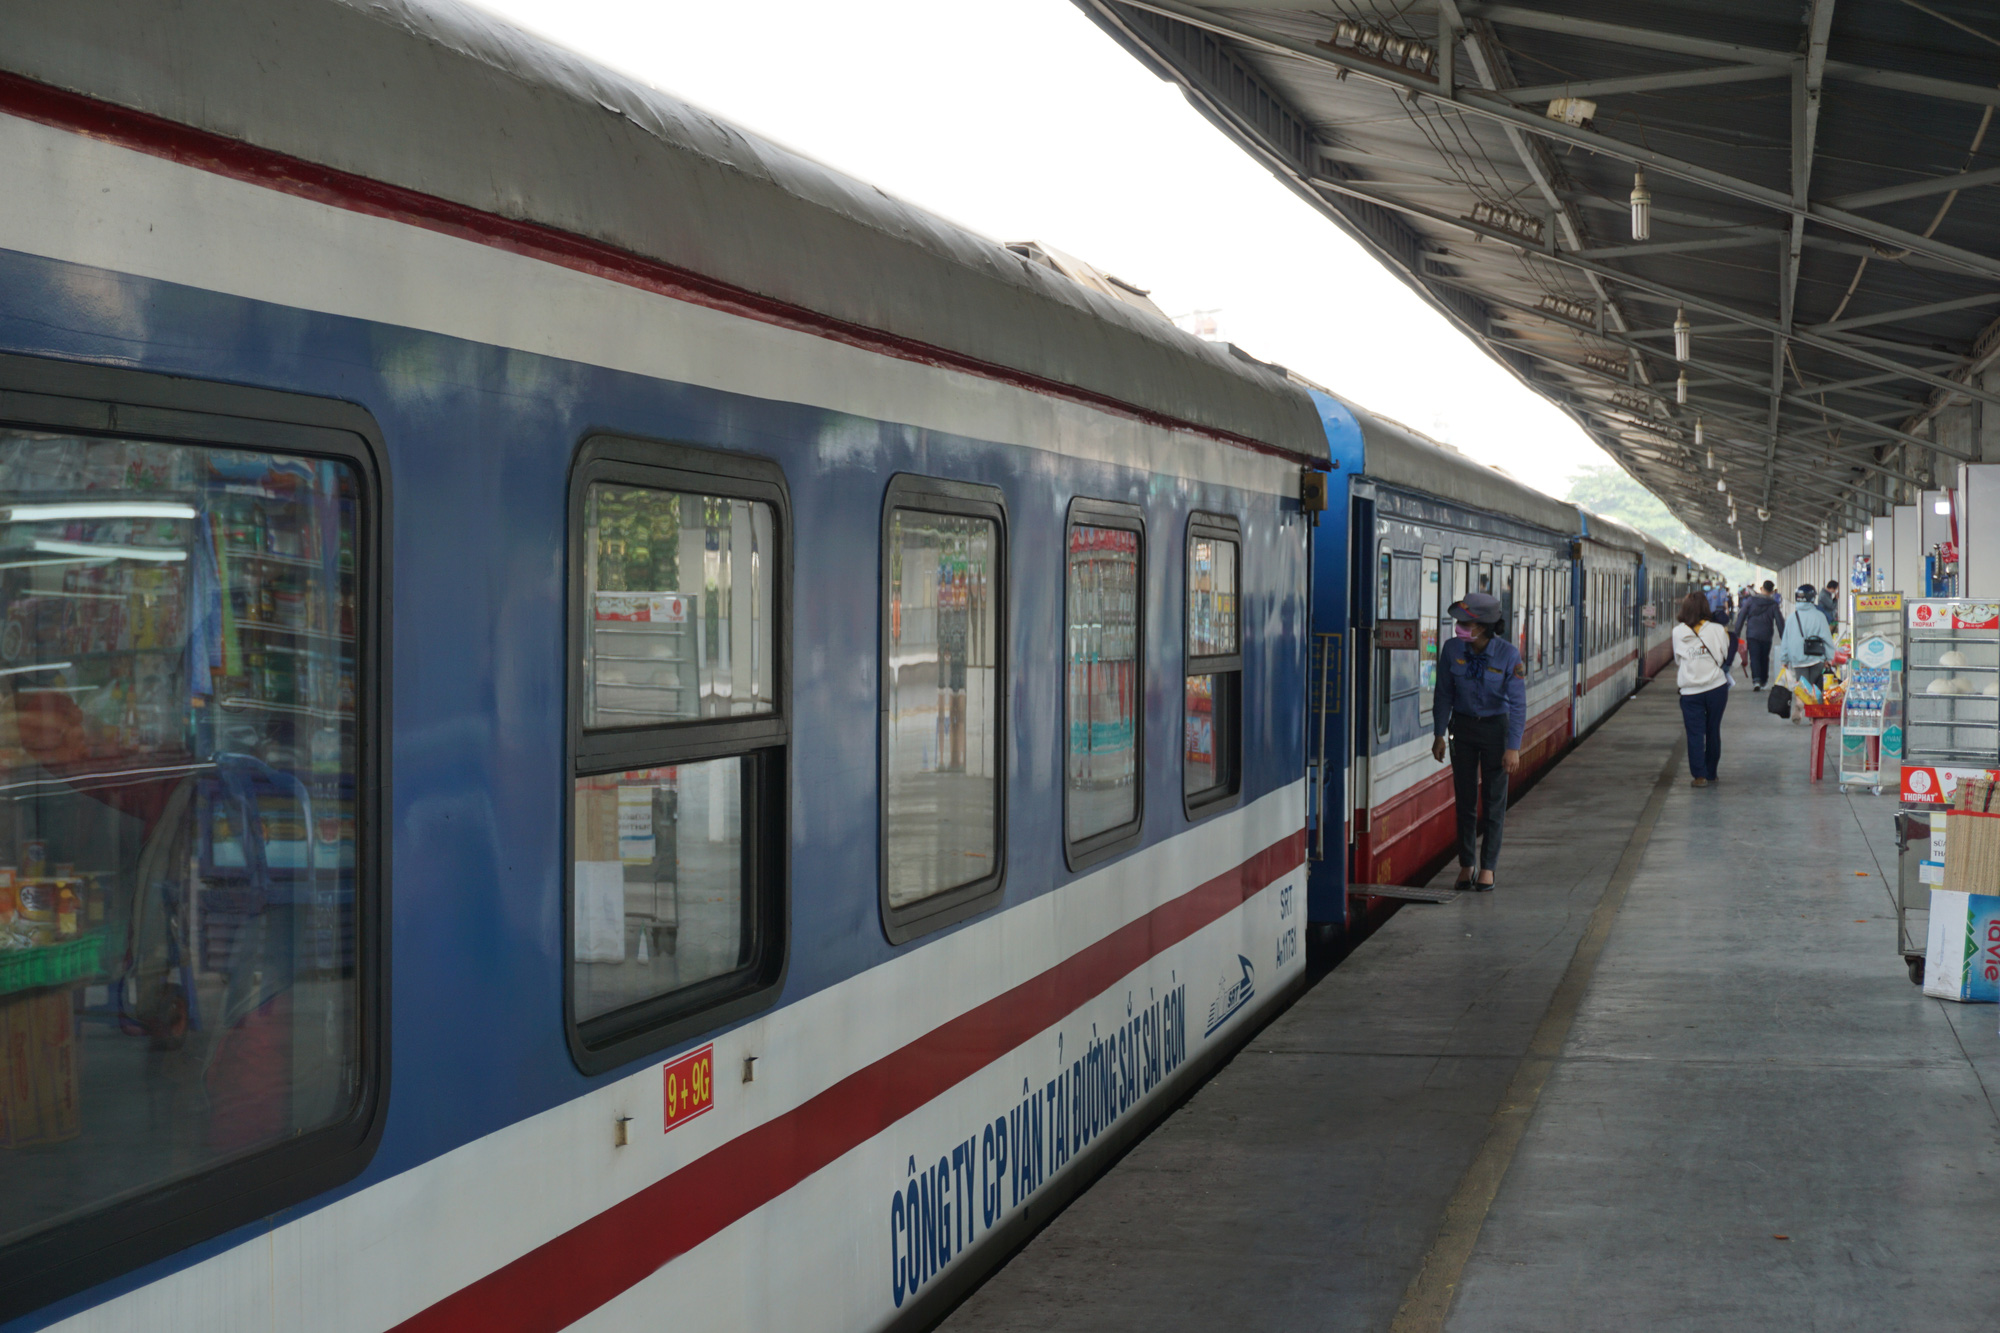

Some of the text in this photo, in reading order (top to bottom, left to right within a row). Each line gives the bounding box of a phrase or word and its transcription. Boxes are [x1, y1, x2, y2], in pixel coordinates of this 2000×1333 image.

[1384, 627, 1413, 641] TOA 8
[1280, 885, 1293, 920] SRT
[668, 1073, 677, 1118] 9
[692, 1058, 709, 1106] 9G
[891, 969, 1186, 1309] CÔNG TY CP VẬN TẢI ĐƯỜNG SẮT SÀI GÒN
